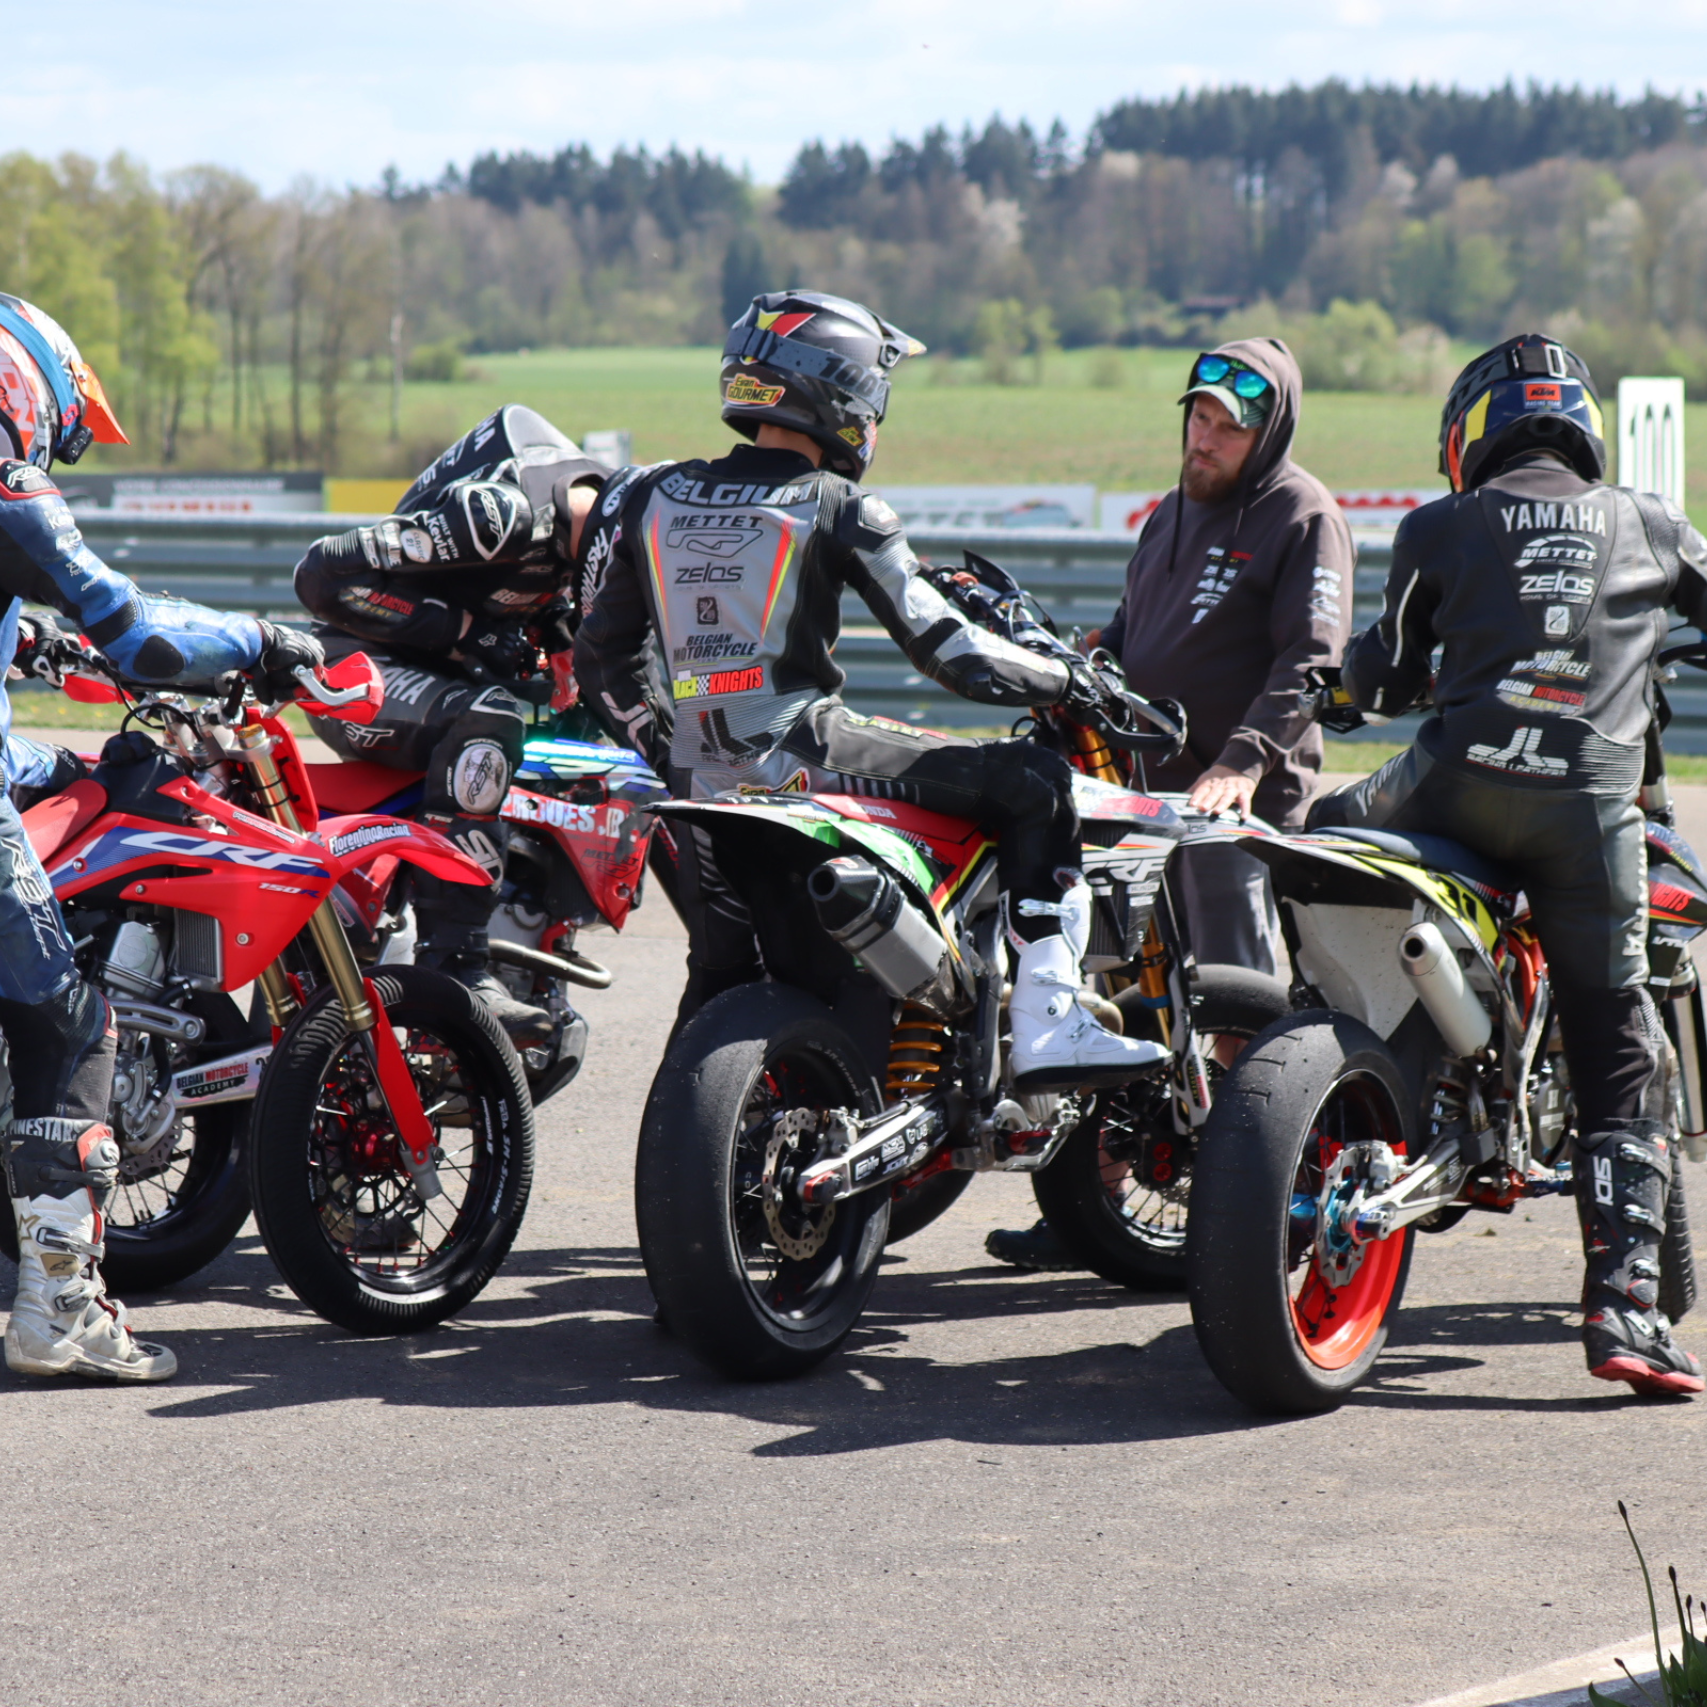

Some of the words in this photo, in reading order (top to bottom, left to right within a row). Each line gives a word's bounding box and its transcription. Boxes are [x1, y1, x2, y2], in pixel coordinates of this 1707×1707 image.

[818, 356, 889, 411] 100%
[1530, 386, 1556, 397] KTM
[727, 386, 781, 403] GOURMET
[659, 471, 815, 506] BELGIUM
[670, 515, 763, 528] METTET
[1501, 502, 1606, 538] YAMAHA
[427, 517, 450, 563] Kevlar
[1520, 546, 1597, 562] METTET
[686, 633, 734, 647] BELGIAN
[673, 642, 758, 662] MOTORCYCLE
[708, 666, 764, 695] KNIGHTS
[1496, 679, 1536, 697] BELGIAN
[1531, 685, 1586, 706] MOTORCYCLE
[1508, 695, 1562, 711] ACADEMY
[120, 832, 324, 870] CRF
[259, 882, 321, 898] 150R
[177, 1073, 205, 1089] BELGIAN
[205, 1062, 249, 1082] MOTORCYCLE
[190, 1079, 236, 1096] ACADEMY
